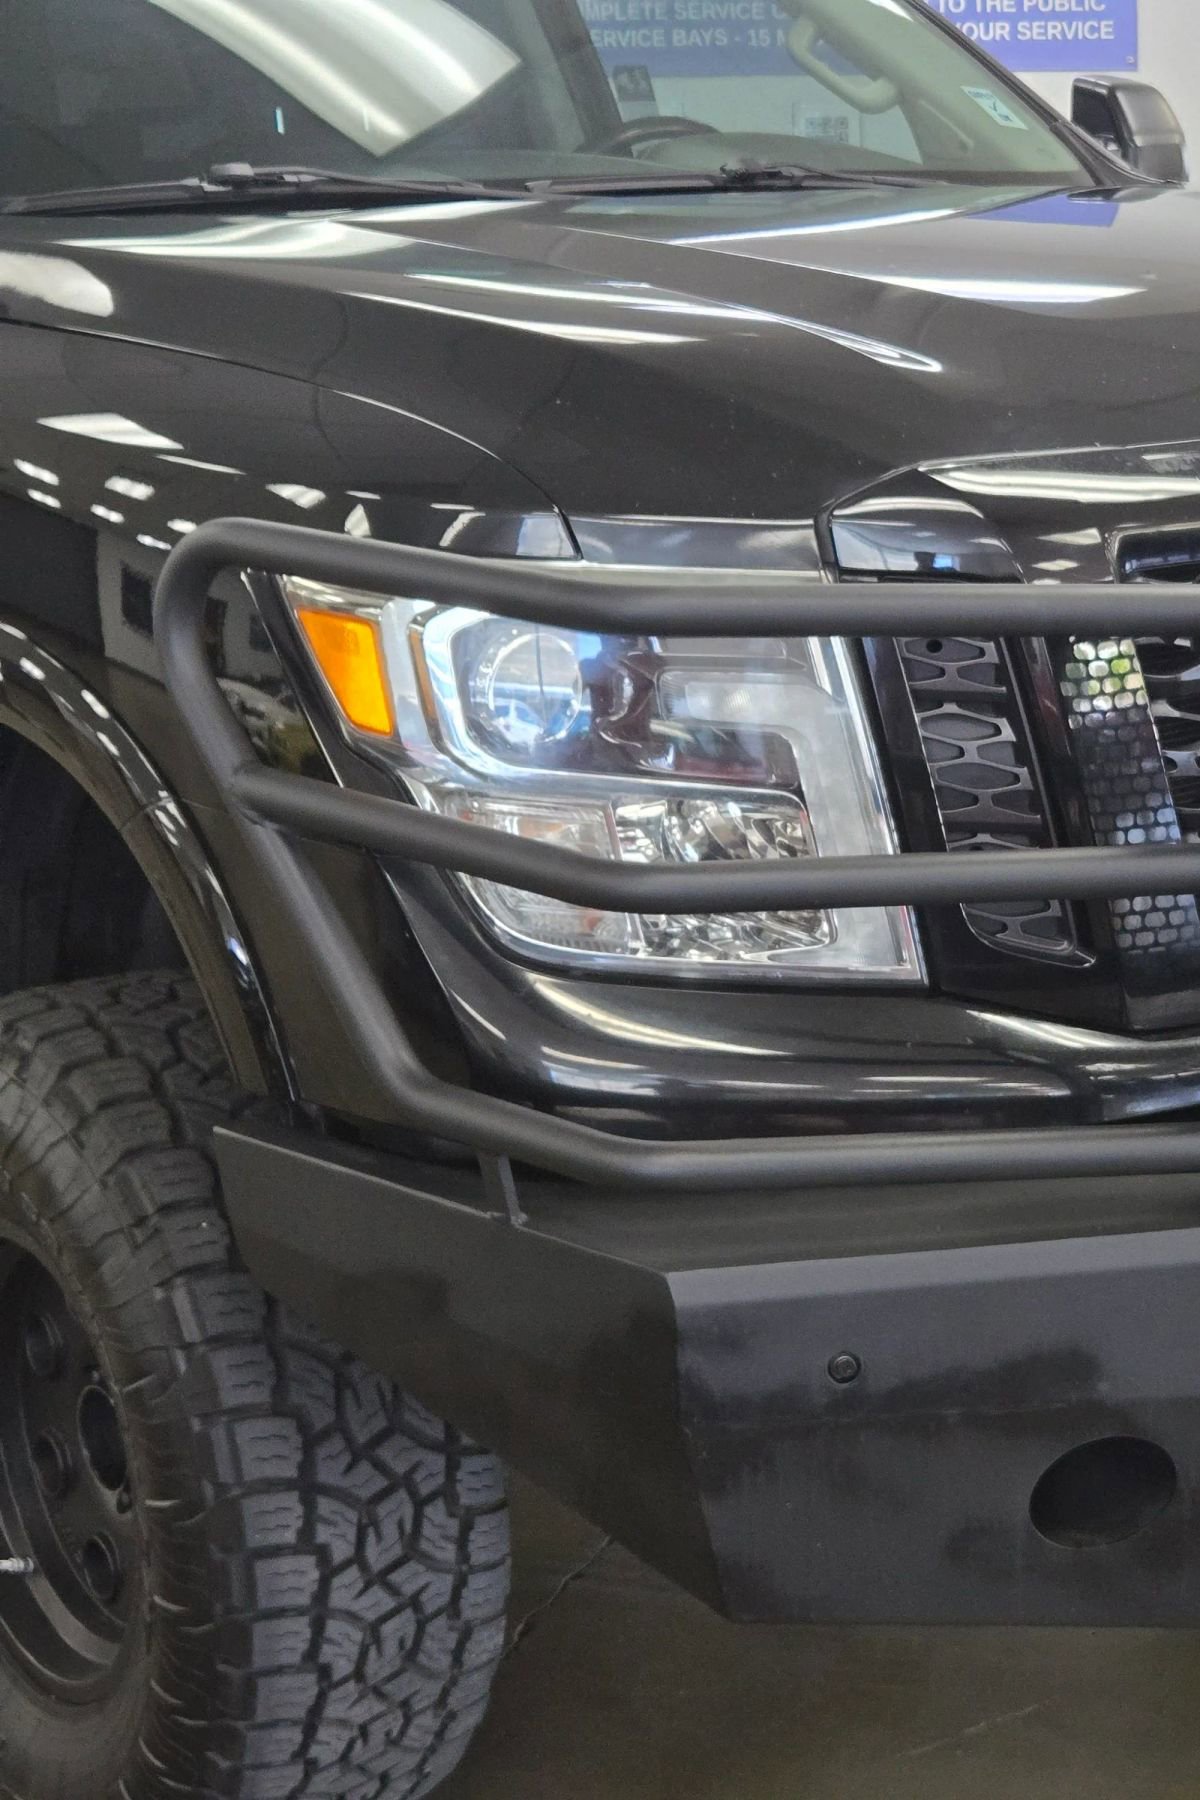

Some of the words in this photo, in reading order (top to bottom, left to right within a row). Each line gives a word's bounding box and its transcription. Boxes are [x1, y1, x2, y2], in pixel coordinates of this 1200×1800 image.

[673, 2, 765, 20] SERVICE
[975, 0, 1017, 13] THE
[1023, 0, 1107, 12] PUBLIC
[672, 28, 728, 47] BAYS
[747, 29, 769, 47] 15
[956, 22, 1010, 41] OUR
[1017, 21, 1115, 40] SERVICE
